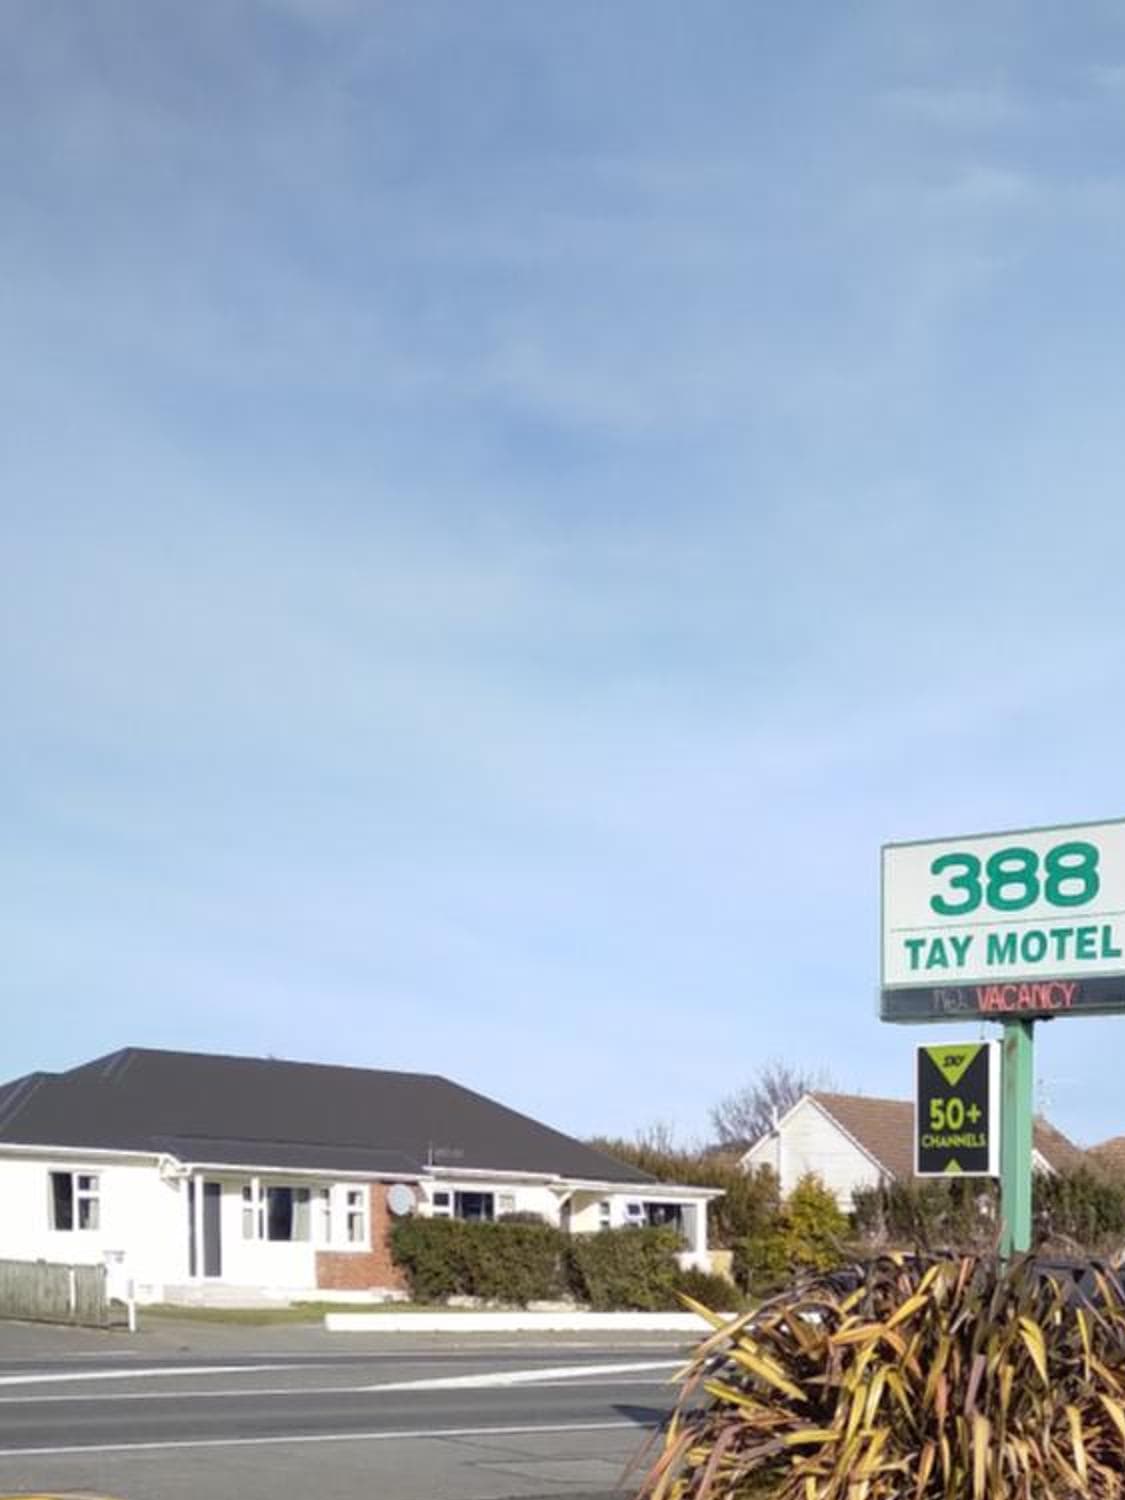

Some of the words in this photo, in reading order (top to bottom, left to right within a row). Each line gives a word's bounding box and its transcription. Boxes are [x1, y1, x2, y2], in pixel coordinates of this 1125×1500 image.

[931, 841, 1099, 916] 388
[904, 936, 973, 970] TAY
[986, 925, 1122, 965] MOTEL
[976, 982, 1076, 1012] VACANCY
[929, 1098, 982, 1130] 50+
[921, 1133, 986, 1147] CHANNELS
